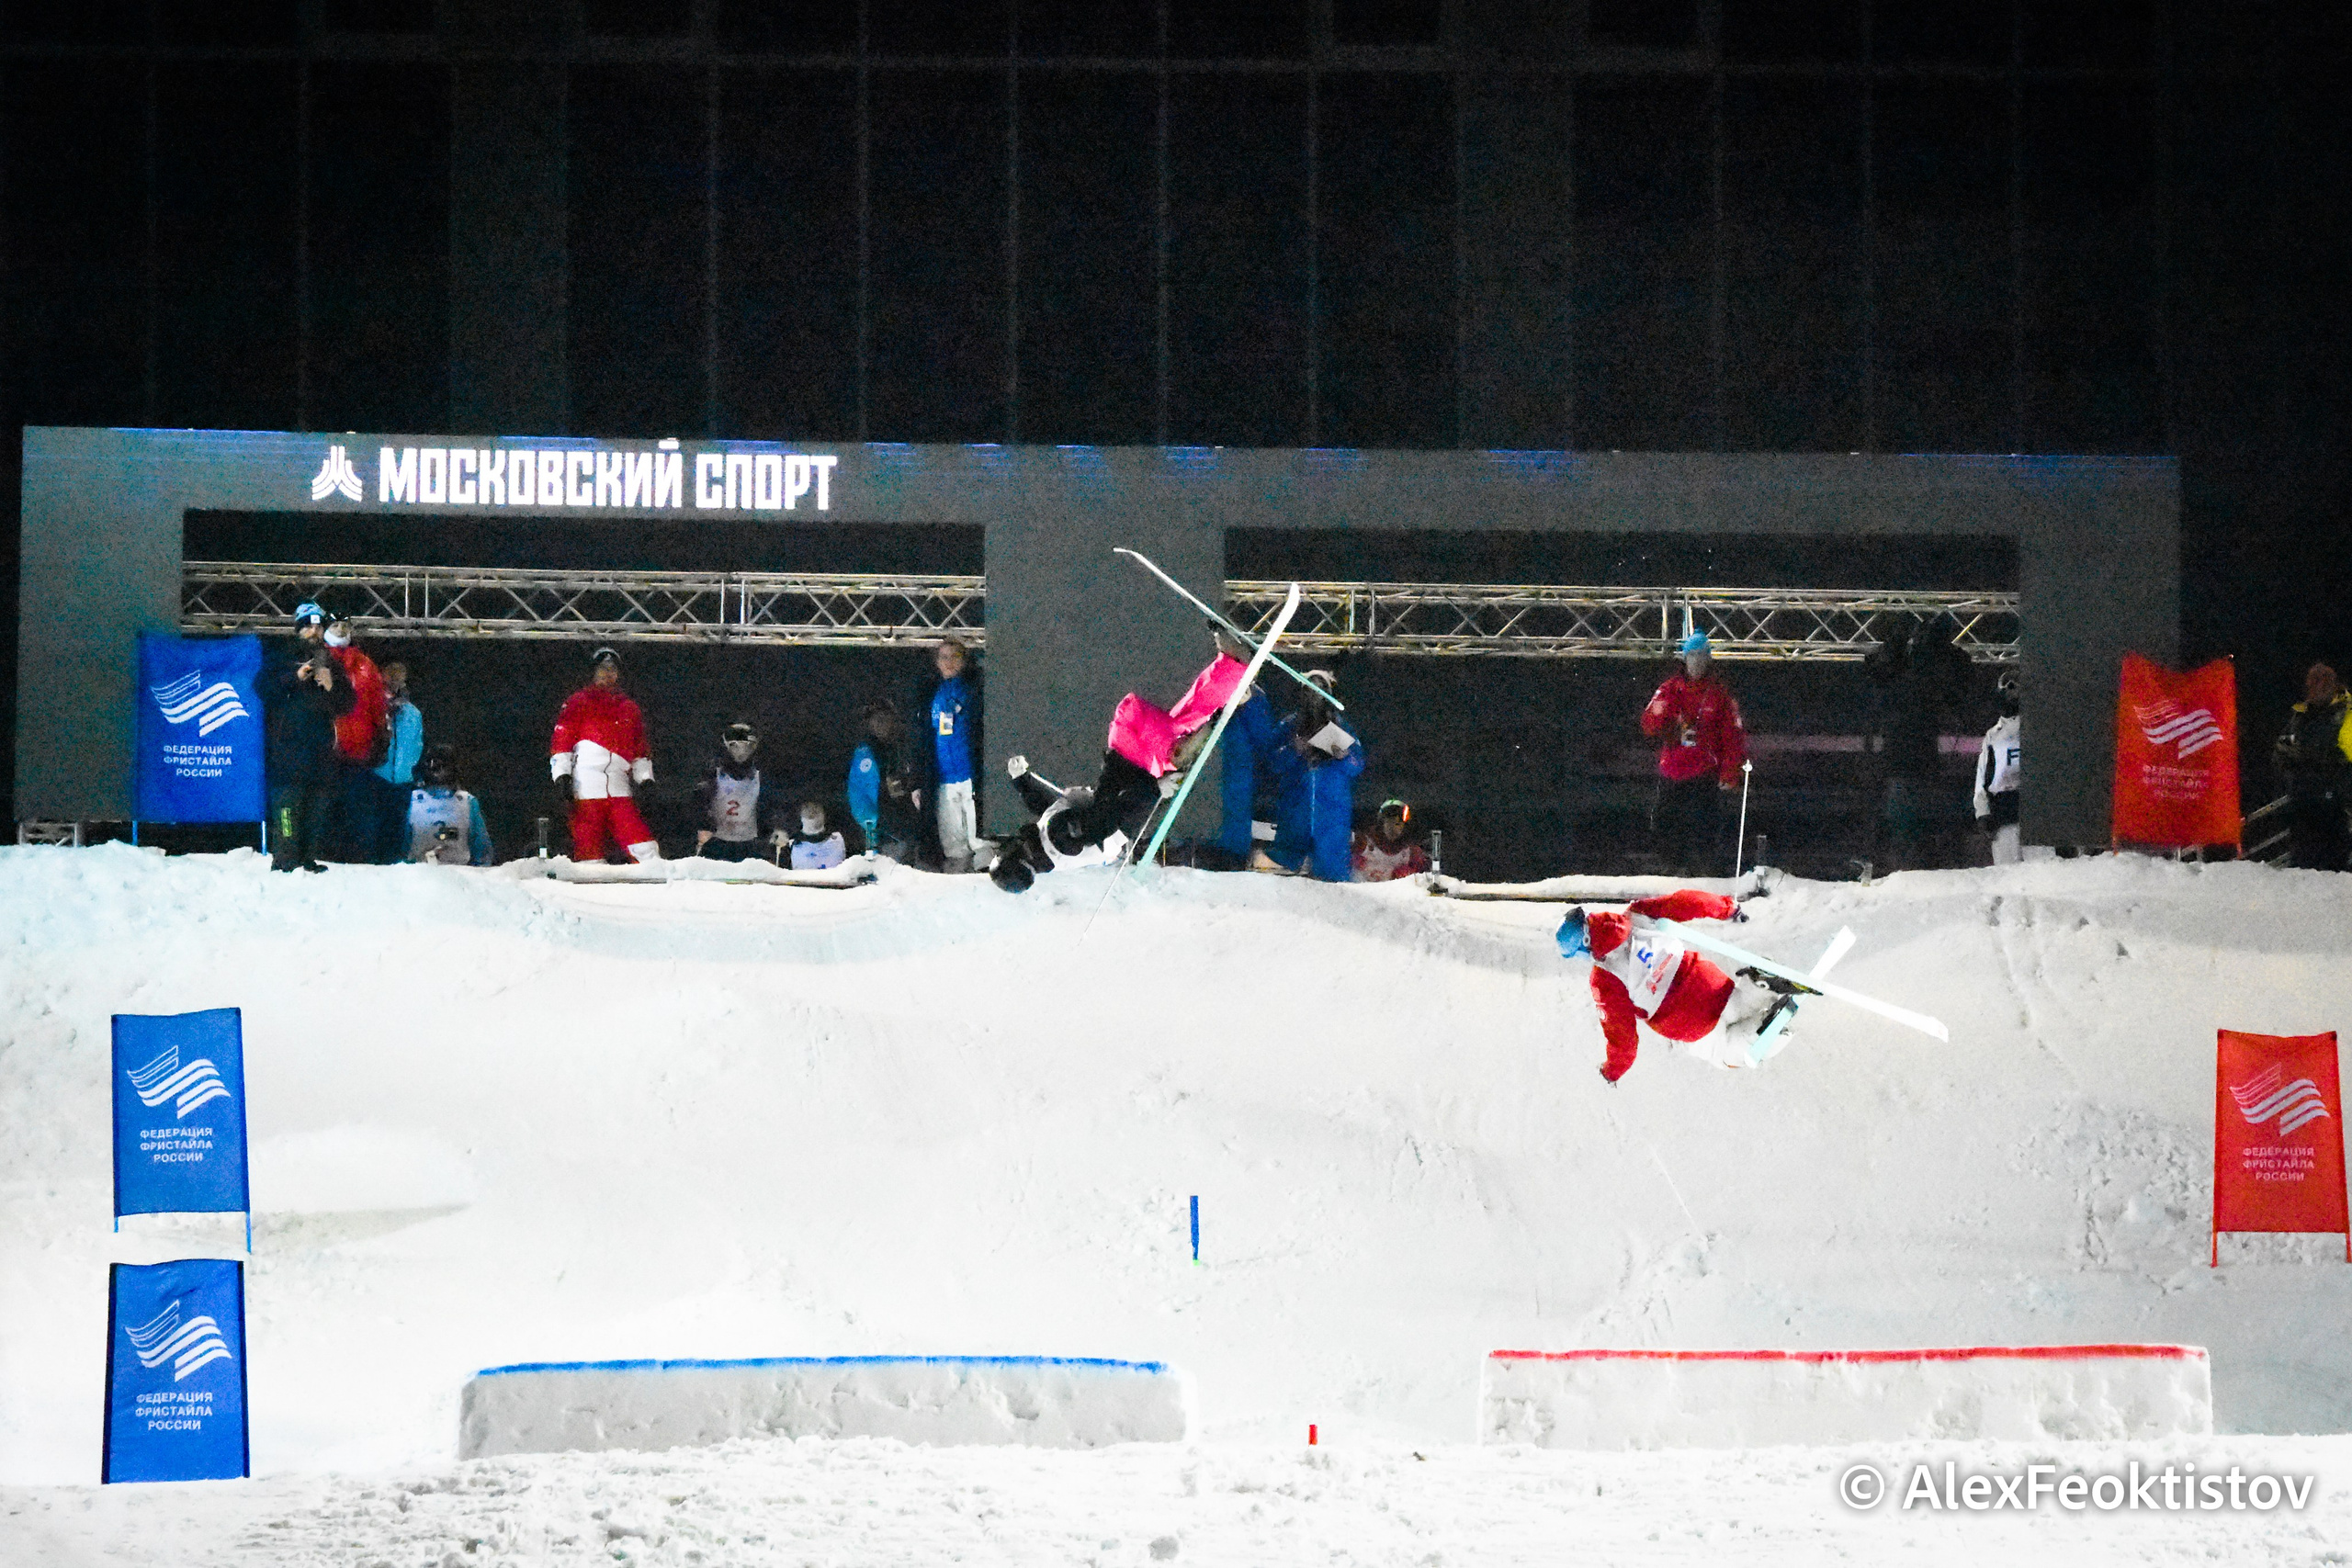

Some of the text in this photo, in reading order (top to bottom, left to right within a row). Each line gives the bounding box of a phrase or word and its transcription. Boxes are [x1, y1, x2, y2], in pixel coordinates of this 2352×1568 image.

[378, 437, 837, 511] МОСКОВСКИЙ СПОРТ
[164, 745, 232, 756] ФЕДЕРАЦИЯ
[164, 756, 232, 766] ФРИСТАЙЛА
[175, 768, 222, 778] РОССИИ
[726, 799, 741, 817] 2
[140, 1127, 213, 1139] ФЕДЕРАЦИЯ
[140, 1139, 213, 1151] ФРИСТАЙЛА
[153, 1152, 204, 1163] РОССИИ
[2243, 1147, 2314, 1157] ФЕДЕРАЦИЯ
[2255, 1171, 2305, 1181] РОССИИ
[135, 1392, 213, 1404] ФЕДЕРАЦИЯ
[135, 1404, 213, 1417] ФРИСТАЙЛА
[148, 1420, 202, 1431] РОССИИ
